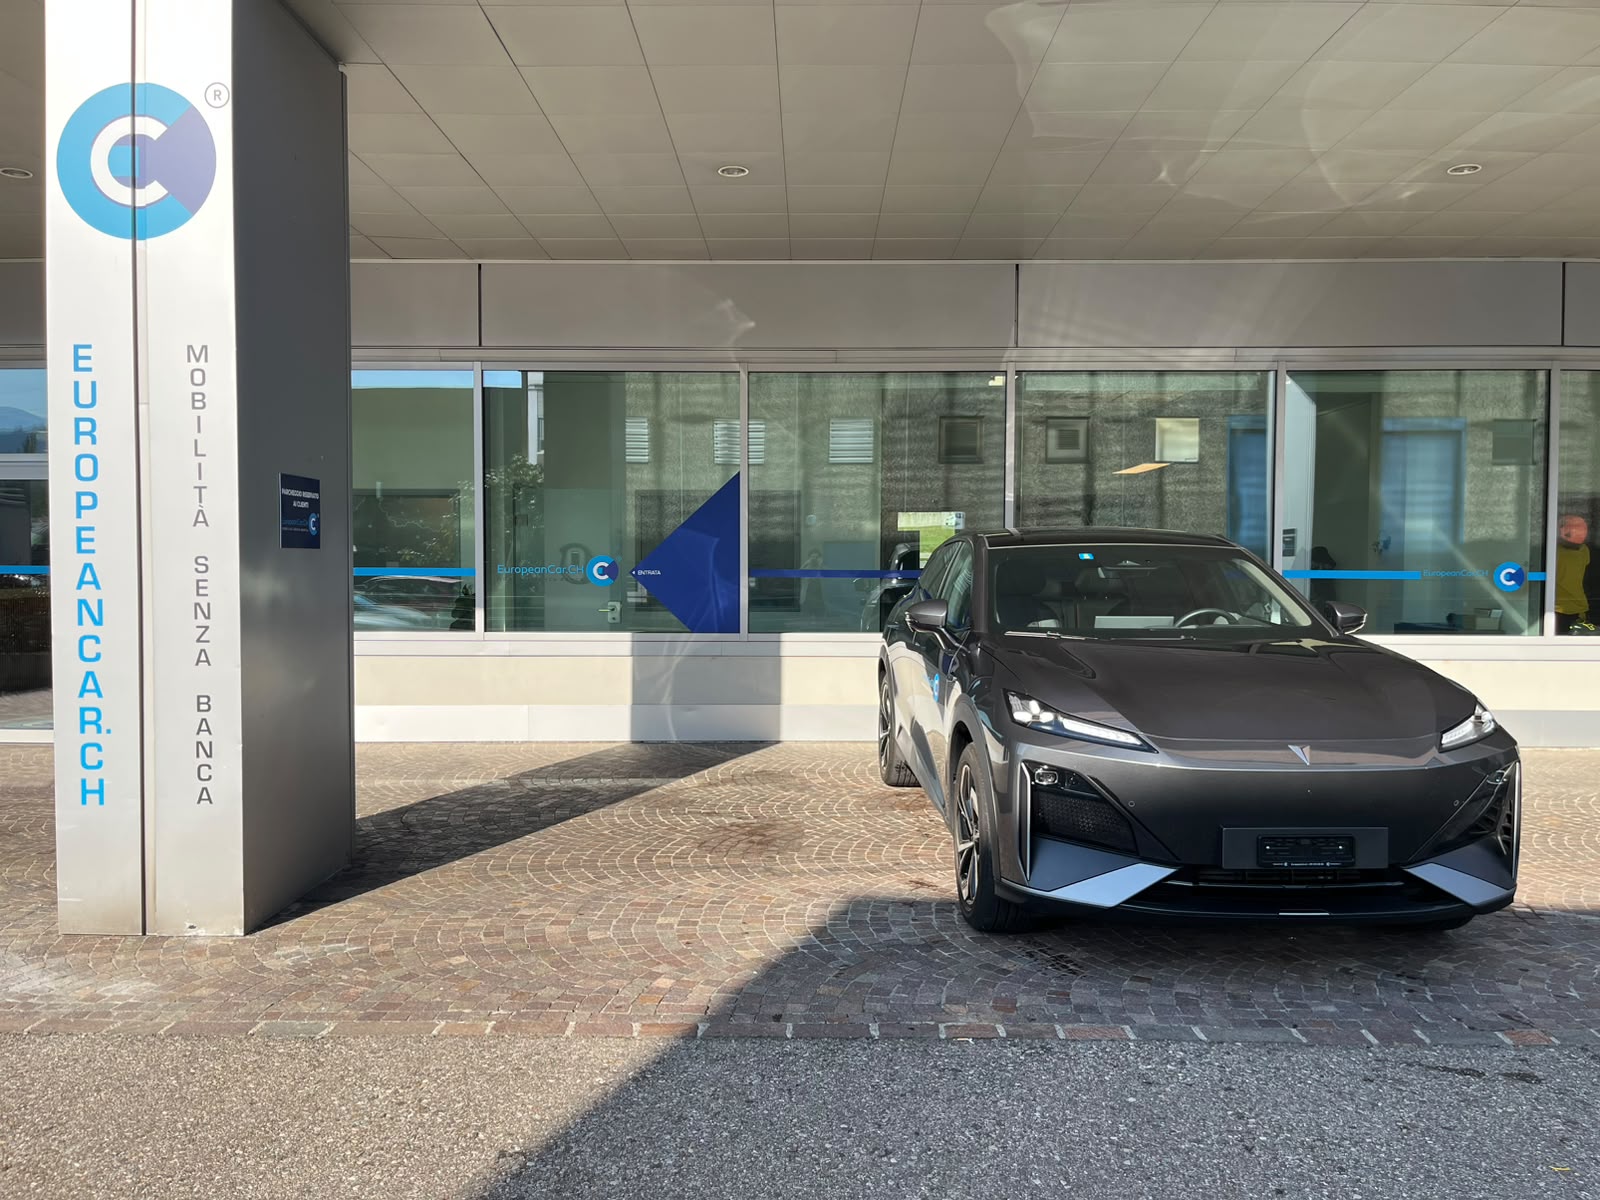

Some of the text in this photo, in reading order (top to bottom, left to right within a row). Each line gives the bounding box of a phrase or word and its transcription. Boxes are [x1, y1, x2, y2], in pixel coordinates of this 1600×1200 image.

[73, 344, 112, 806] EUROPEANCAR.CH
[187, 344, 213, 805] MOBILITÀ SENZA BANCA
[497, 564, 585, 576] EuropeanCar.CH
